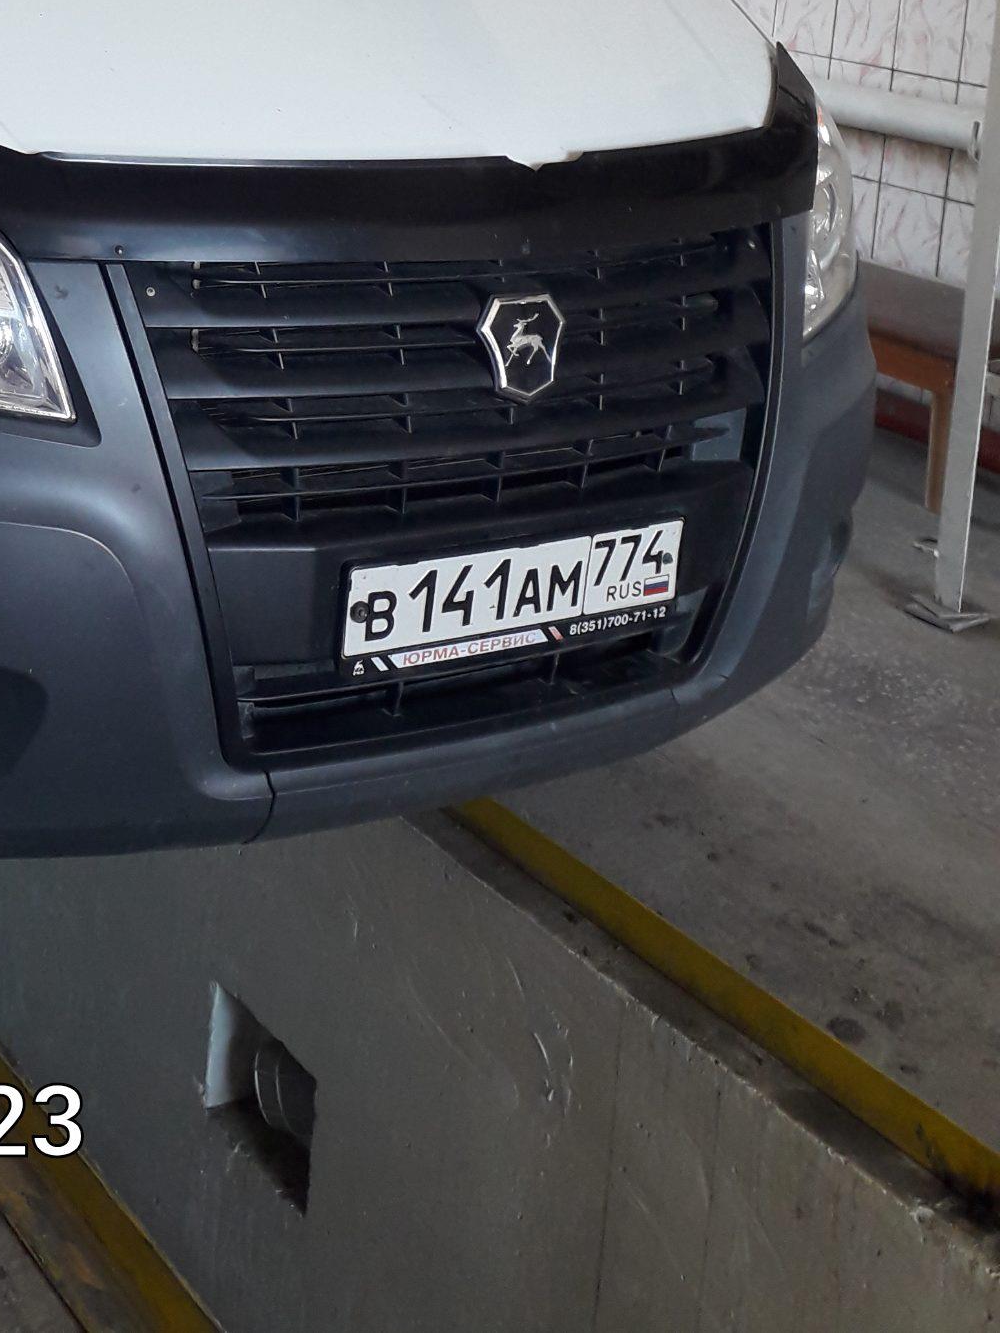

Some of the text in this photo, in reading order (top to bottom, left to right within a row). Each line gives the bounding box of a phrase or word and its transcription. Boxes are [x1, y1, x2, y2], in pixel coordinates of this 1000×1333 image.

[593, 529, 665, 587] 774
[605, 581, 642, 603] RUS
[569, 606, 667, 636] 8(351)700-71-12
[402, 631, 537, 666] ЮРМА-СЕРВИС
